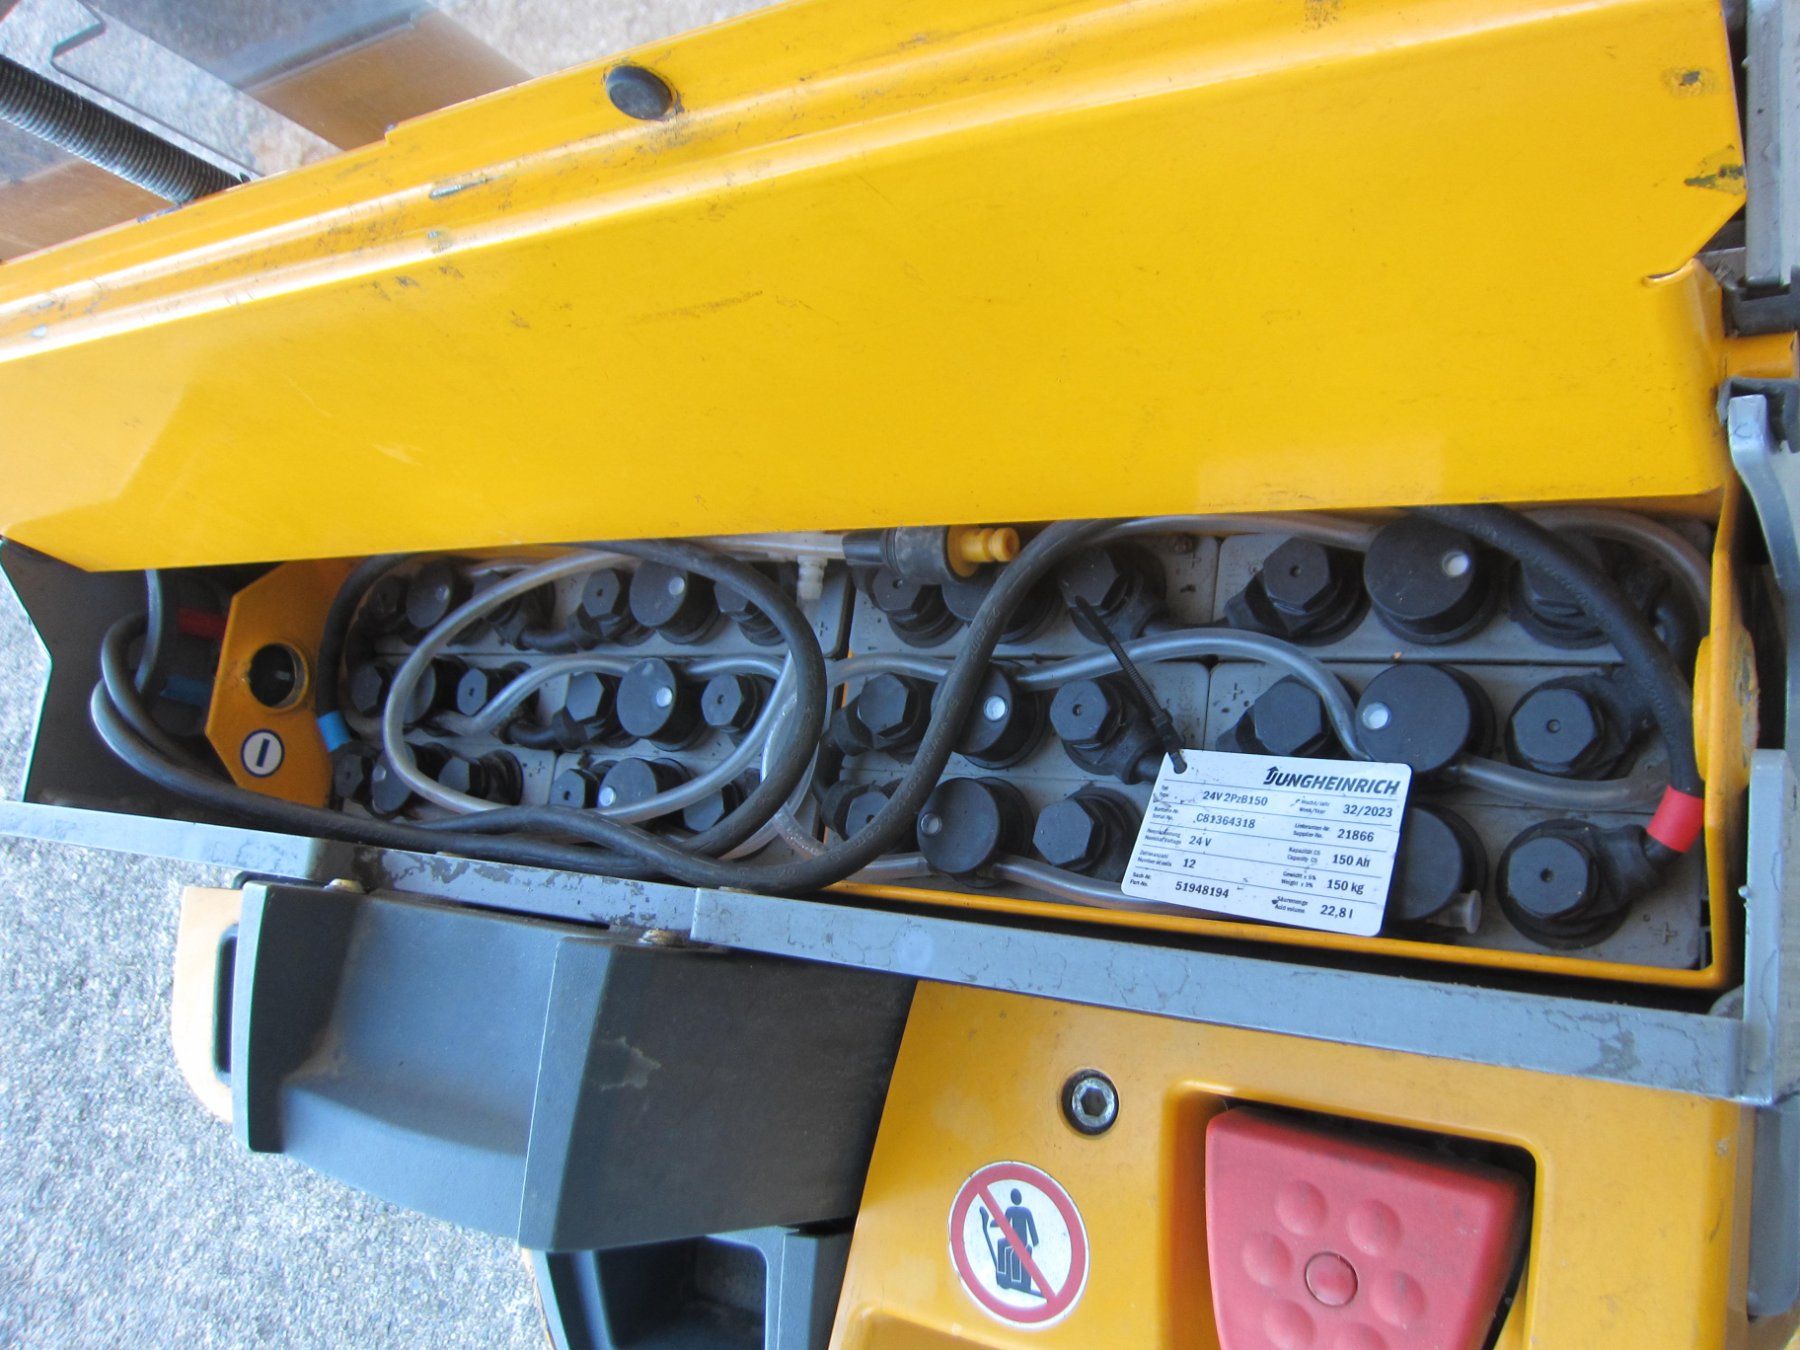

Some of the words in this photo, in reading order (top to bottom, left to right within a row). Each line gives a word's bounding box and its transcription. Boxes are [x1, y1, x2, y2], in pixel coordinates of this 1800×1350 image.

[1263, 766, 1401, 795] JUNGHEINRICH
[1343, 804, 1393, 818] 32/2023
[1196, 813, 1256, 829] C81364318
[1188, 835, 1203, 846] 24
[1204, 838, 1212, 847] V
[1337, 828, 1375, 842] 21866
[1183, 858, 1196, 868] 12
[1332, 854, 1354, 866] 150
[1355, 857, 1371, 868] Ah
[1175, 881, 1230, 898] 51948194
[1326, 879, 1349, 891] 150
[1350, 882, 1365, 895] kg
[1320, 904, 1347, 919] 22,8
